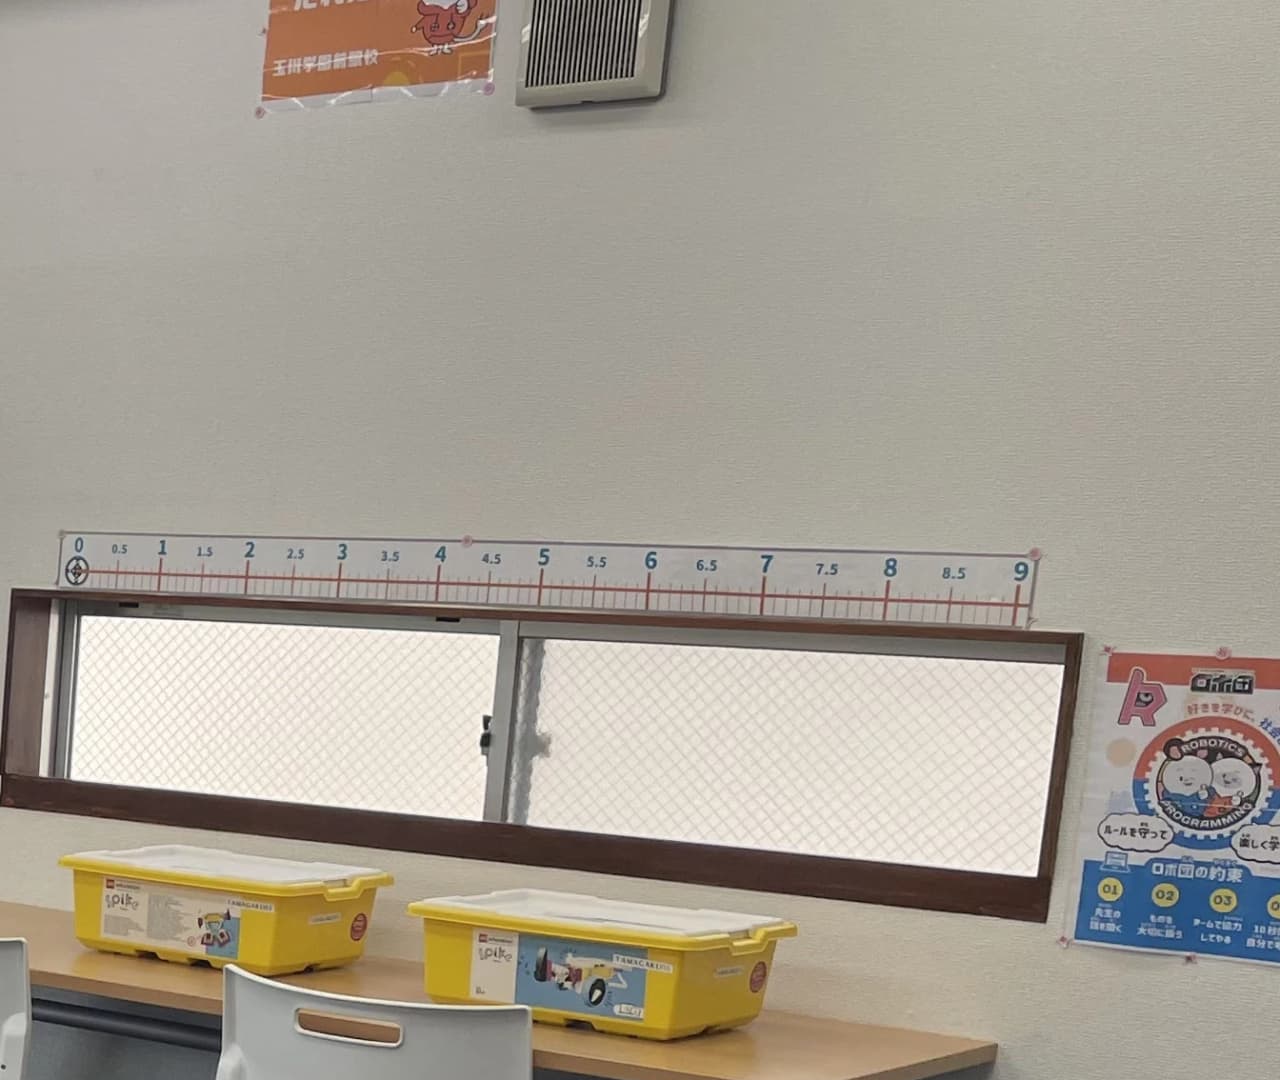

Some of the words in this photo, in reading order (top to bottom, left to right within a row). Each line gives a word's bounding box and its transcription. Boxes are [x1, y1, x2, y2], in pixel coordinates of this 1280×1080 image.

[75, 538, 84, 552] 0
[111, 544, 128, 554] 0.5
[158, 540, 168, 555] 1
[197, 547, 213, 557] 1.5
[245, 542, 255, 558] 2
[287, 549, 305, 560] 2.5
[337, 544, 348, 560] 3
[381, 551, 400, 562] 3.5
[435, 546, 447, 562] 4
[482, 554, 502, 565] 4.5
[538, 549, 550, 566] 5
[587, 556, 607, 568] 5.5
[645, 551, 657, 569] 6
[696, 559, 718, 571] 6.5
[761, 555, 774, 573] 7
[816, 563, 839, 576] 7.5
[884, 558, 898, 577] 8
[942, 567, 966, 580] 8.5
[1014, 561, 1029, 581] 9
[1181, 737, 1246, 757] ROBOTICS
[1160, 800, 1253, 829] PROGRAMMING
[1103, 825, 1169, 840] ルールを守って
[1151, 862, 1243, 883] ロボ団の約束
[1102, 884, 1119, 895] 01
[1155, 890, 1175, 901] 02
[1213, 895, 1233, 906] 03
